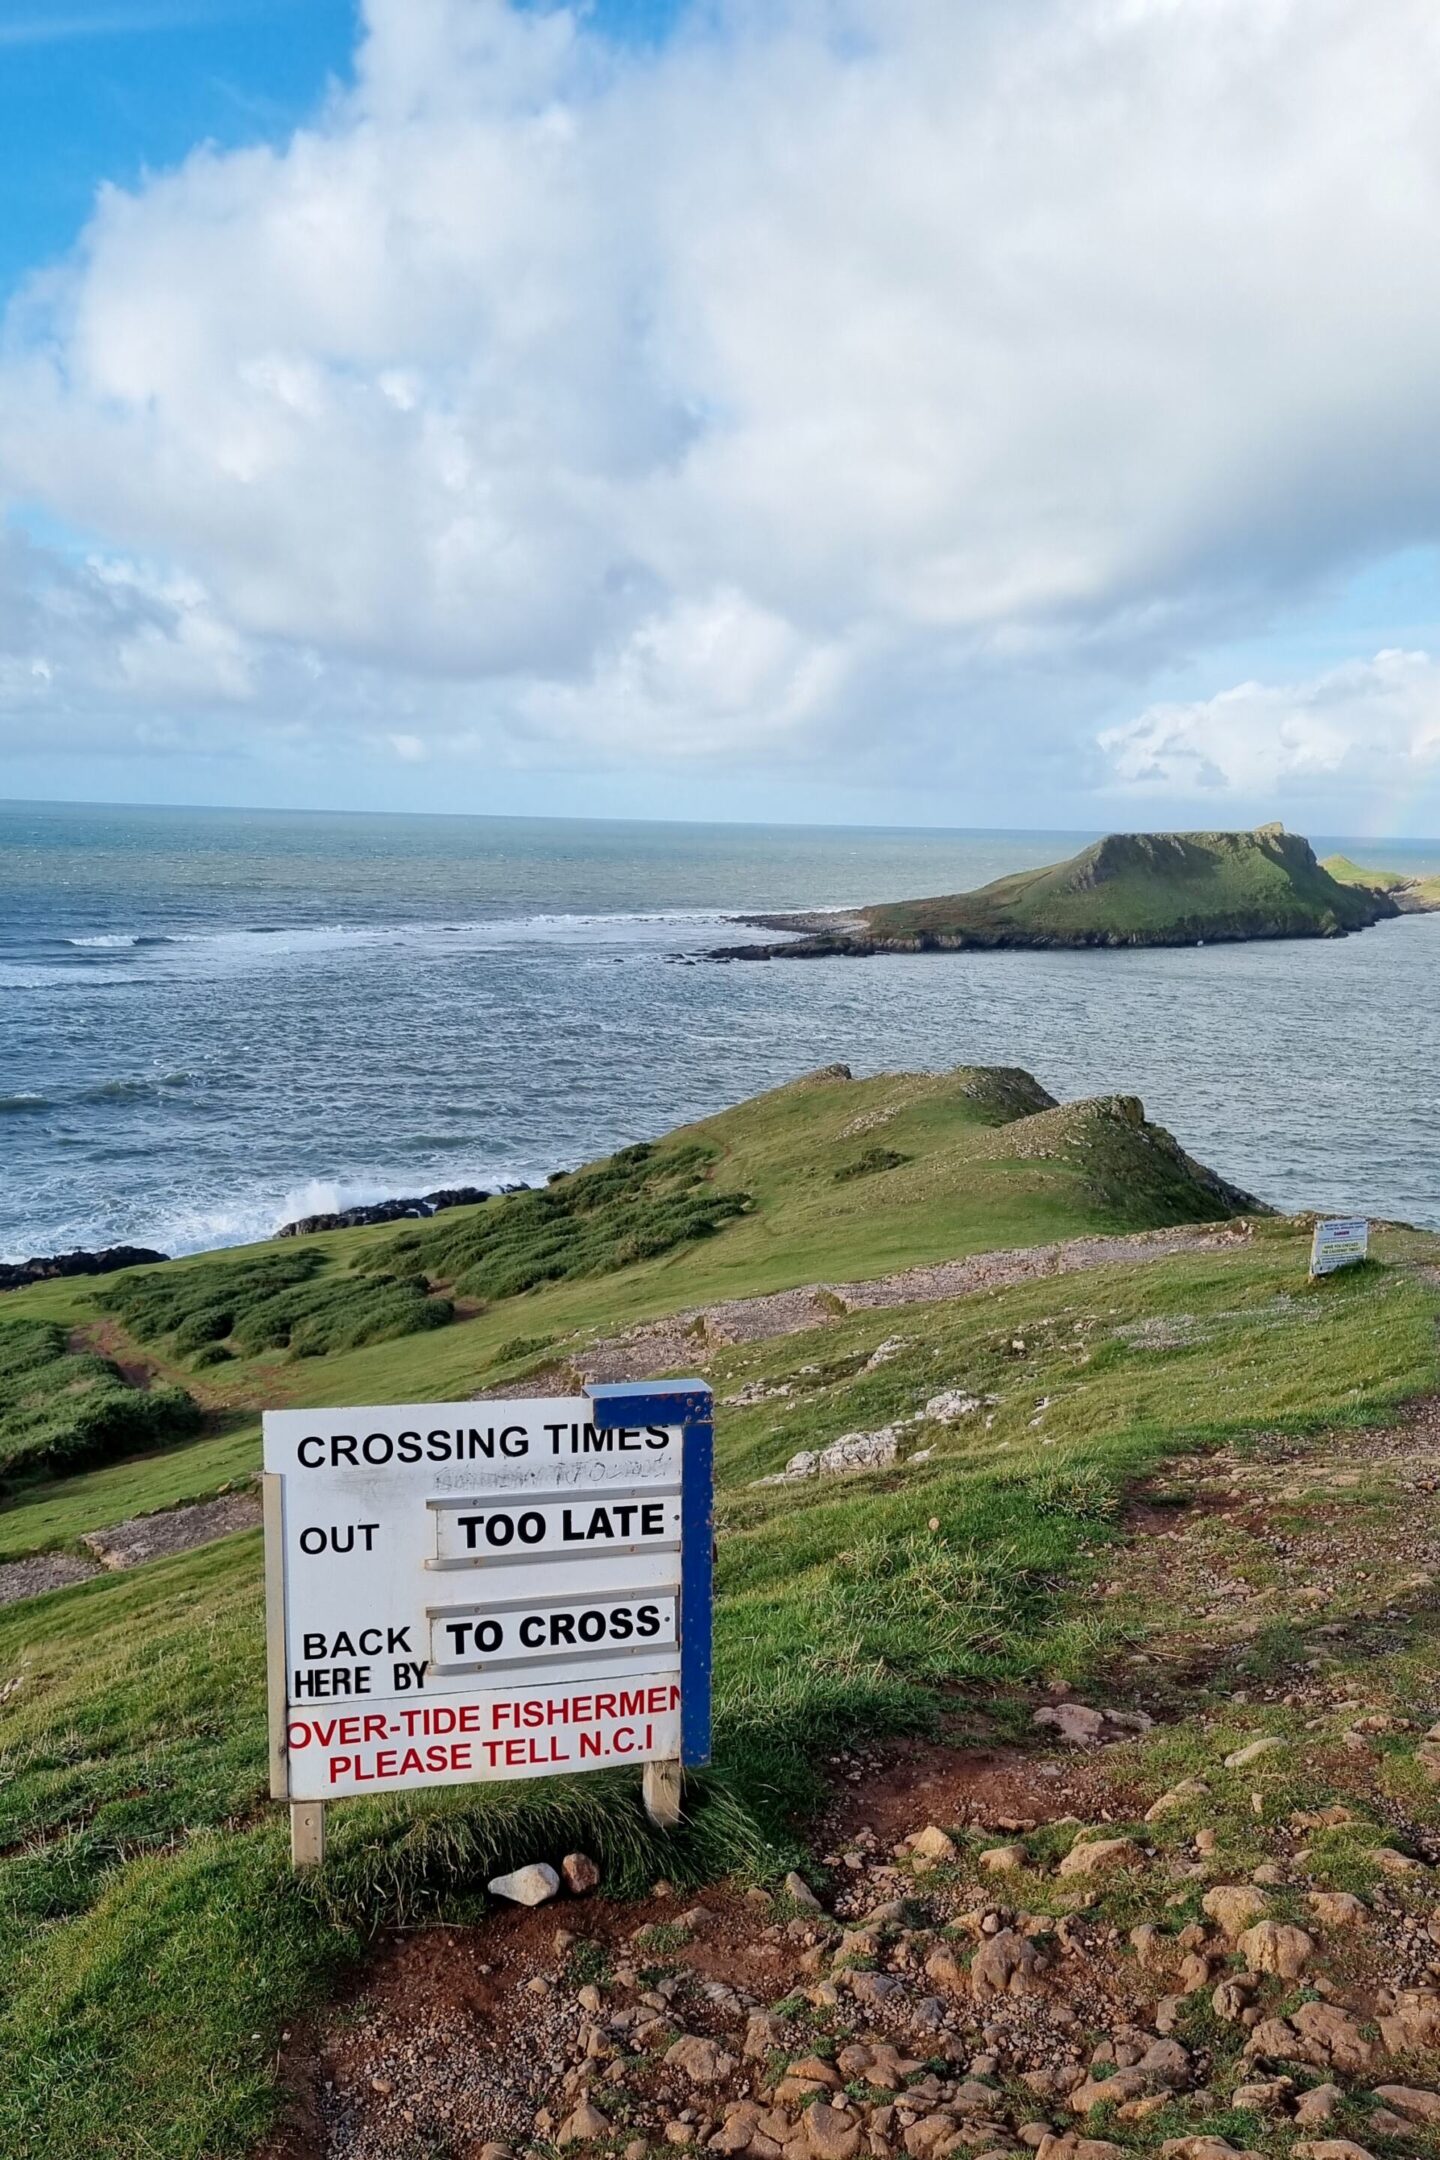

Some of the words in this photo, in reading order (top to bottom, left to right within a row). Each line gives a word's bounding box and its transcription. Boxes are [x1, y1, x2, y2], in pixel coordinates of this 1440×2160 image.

[297, 1426, 529, 1469] CROSSING
[543, 1422, 670, 1455] TIMES
[299, 1523, 380, 1555] OUT
[457, 1511, 547, 1549] TOO
[562, 1503, 665, 1541] LATE
[303, 1626, 412, 1661] BACK
[445, 1620, 504, 1655] TO
[519, 1605, 661, 1648] CROSS
[294, 1665, 371, 1699] HERE
[393, 1660, 430, 1691] BY
[287, 1705, 481, 1751] OVER-TIDE
[329, 1742, 473, 1784] PLEASE
[481, 1735, 570, 1768] TELL
[578, 1723, 654, 1759] N.C.I
